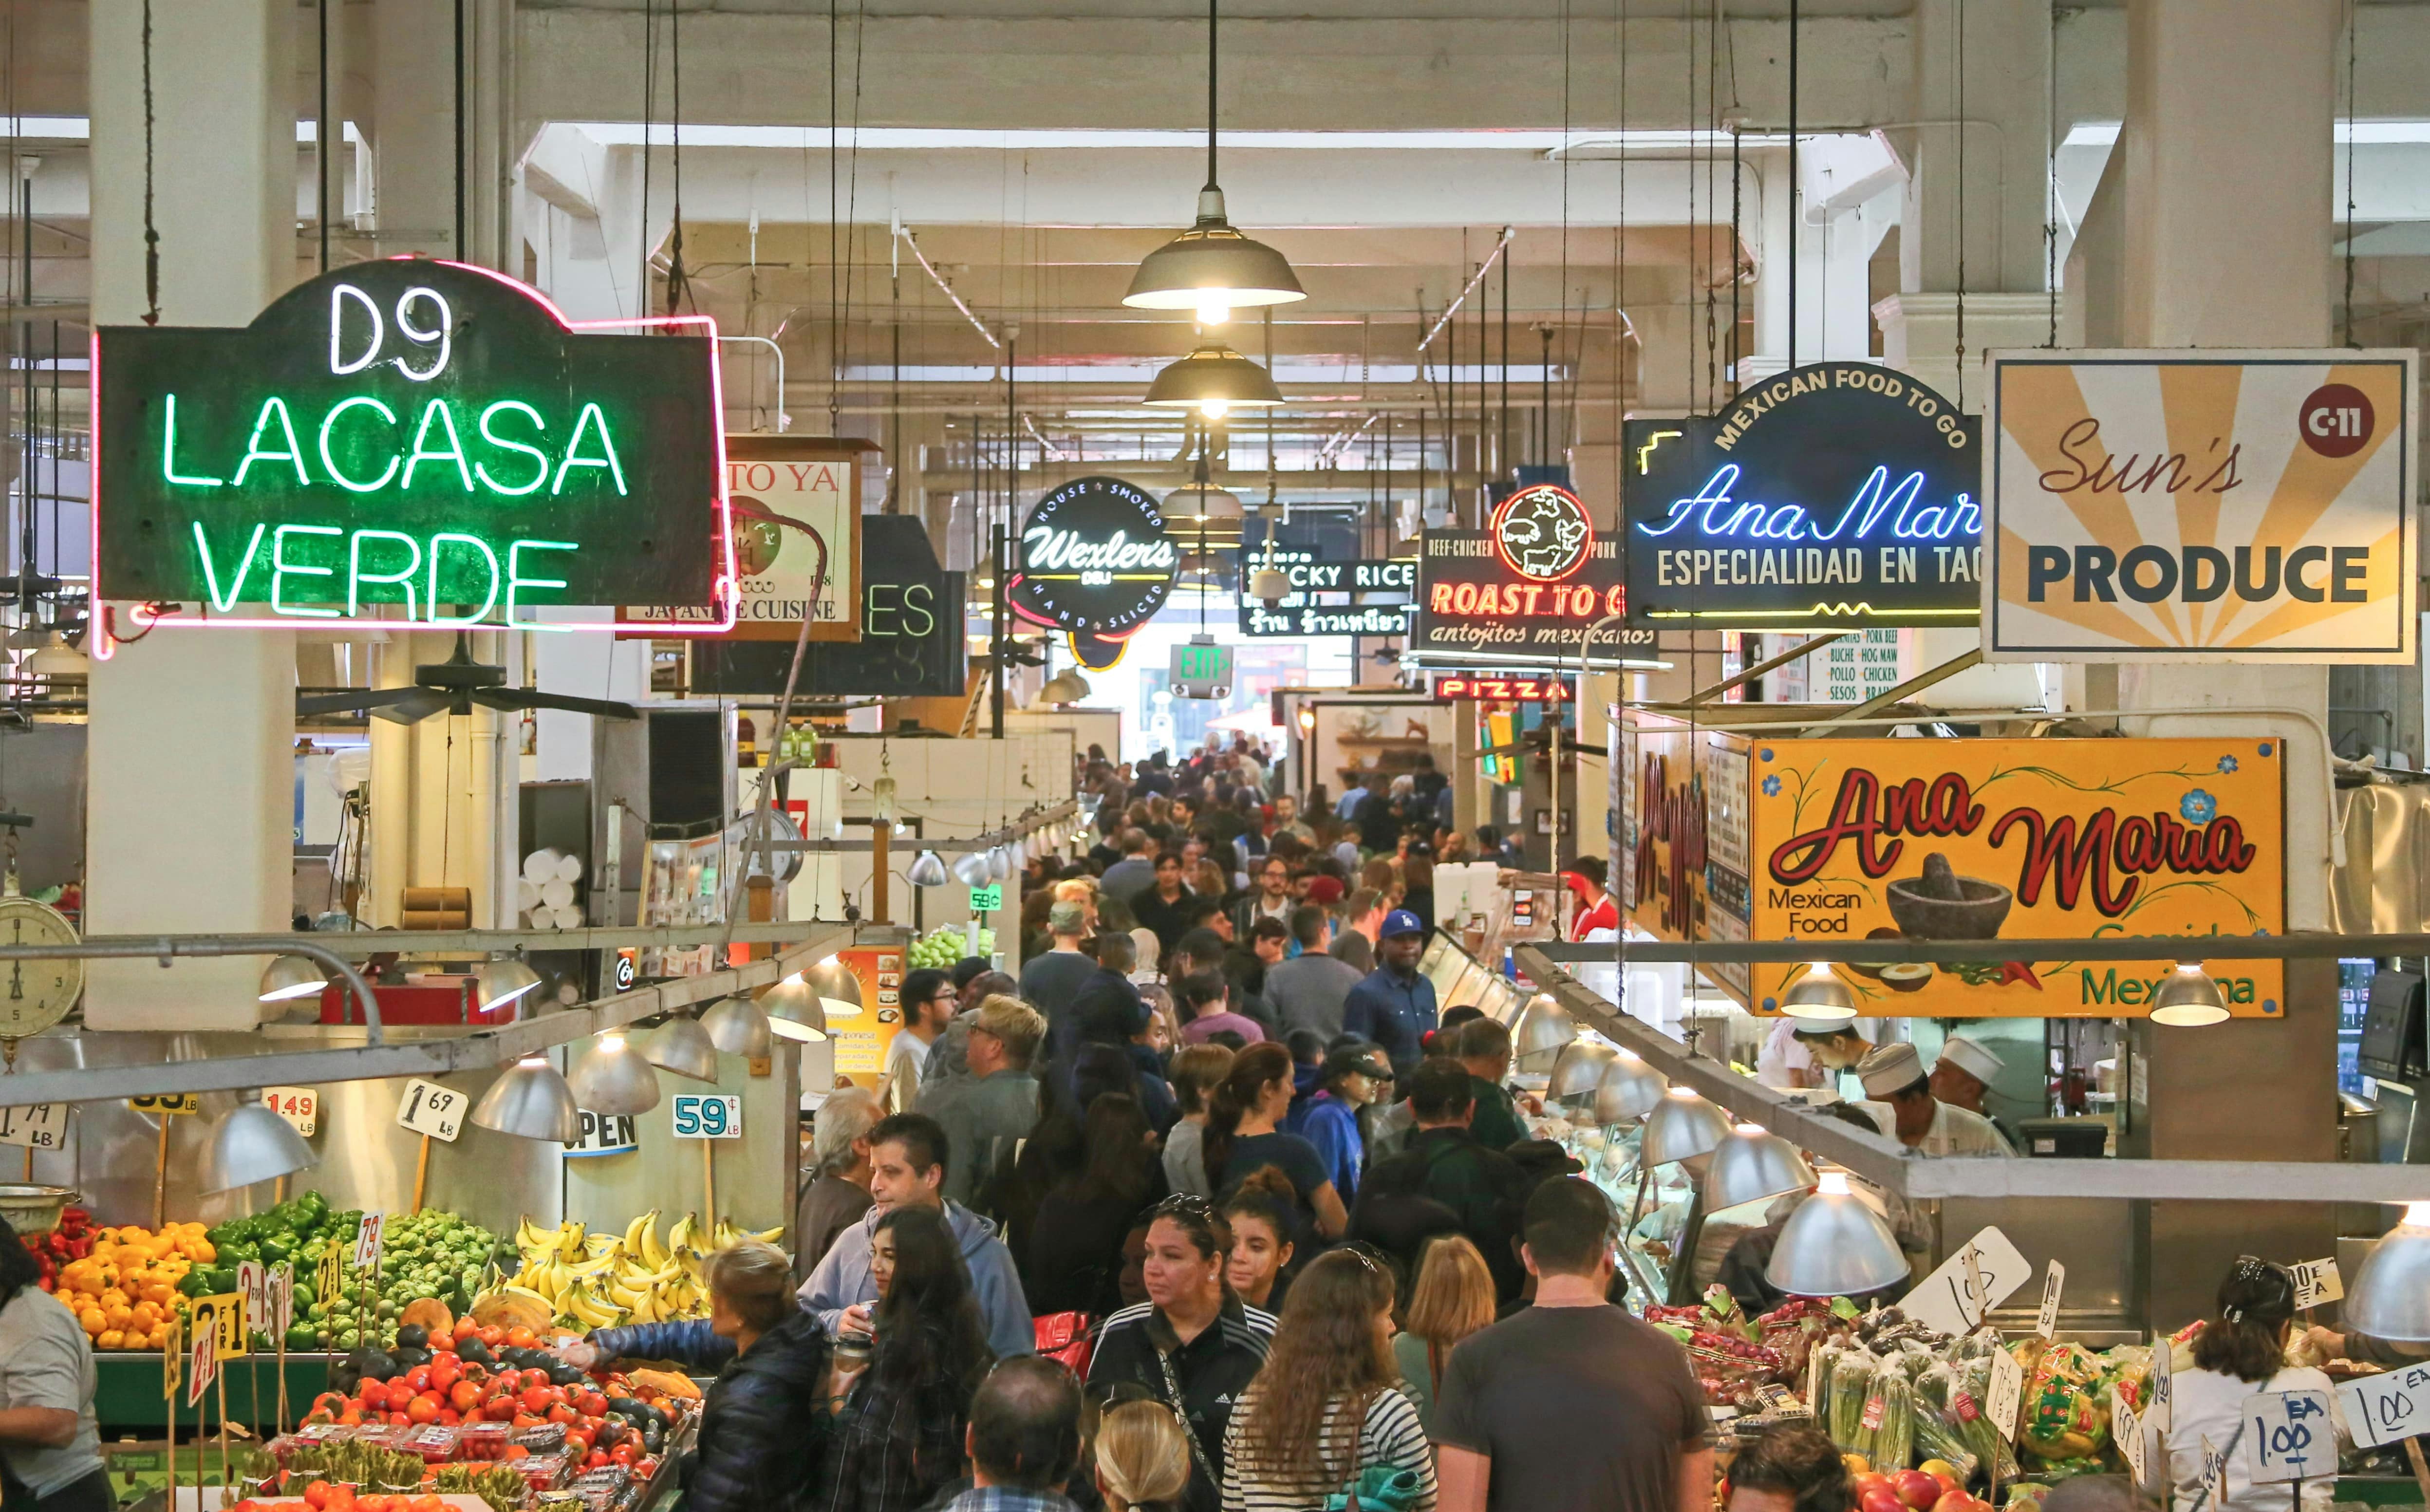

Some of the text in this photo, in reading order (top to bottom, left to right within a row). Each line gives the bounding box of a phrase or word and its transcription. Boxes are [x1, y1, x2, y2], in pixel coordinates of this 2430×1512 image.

[331, 284, 452, 381] D9
[1714, 370, 1967, 451] MEXICAN FOOD TO GO
[2039, 418, 2242, 494] Sun's
[787, 464, 839, 492] YA
[1038, 484, 1162, 527] HOUSE SMOKED
[1637, 464, 1806, 541] Ana
[1023, 525, 1176, 569] Wexler's
[1590, 541, 1616, 559] PORK
[193, 521, 579, 633] VERDE
[1356, 565, 1415, 586] RICE
[1658, 548, 1863, 585] ESPECIALIDAD
[1880, 547, 1917, 583] EN
[2027, 545, 2369, 603] PRODUCE
[1033, 585, 1086, 628] HAND
[1110, 585, 1161, 628] SLICED
[1431, 583, 1543, 615] ROAST
[1552, 584, 1595, 616] TO
[1430, 621, 1527, 651] antojitos
[1866, 629, 1883, 643] PORK
[1180, 647, 1223, 680] EXIT
[1831, 648, 1854, 662] BUCHE
[1861, 648, 1898, 663] HOG MAW
[1830, 667, 1856, 681] POLLO
[1863, 667, 1898, 681] CHICKEN
[1439, 680, 1570, 698] PIZZA
[1830, 686, 1857, 700] SESOS
[1769, 767, 1985, 886] Ana
[1988, 806, 2257, 918] Maria
[1768, 889, 1861, 909] Mexican
[1789, 912, 1848, 933] Food
[2082, 968, 2255, 1005] Mexna
[185, 1100, 197, 1110] LB
[31, 1130, 53, 1146] LB
[300, 1123, 314, 1133] LB
[439, 1120, 453, 1137] LB
[564, 1112, 636, 1150] PEN
[728, 1124, 739, 1135] LB
[2256, 1416, 2312, 1467] 1.00
